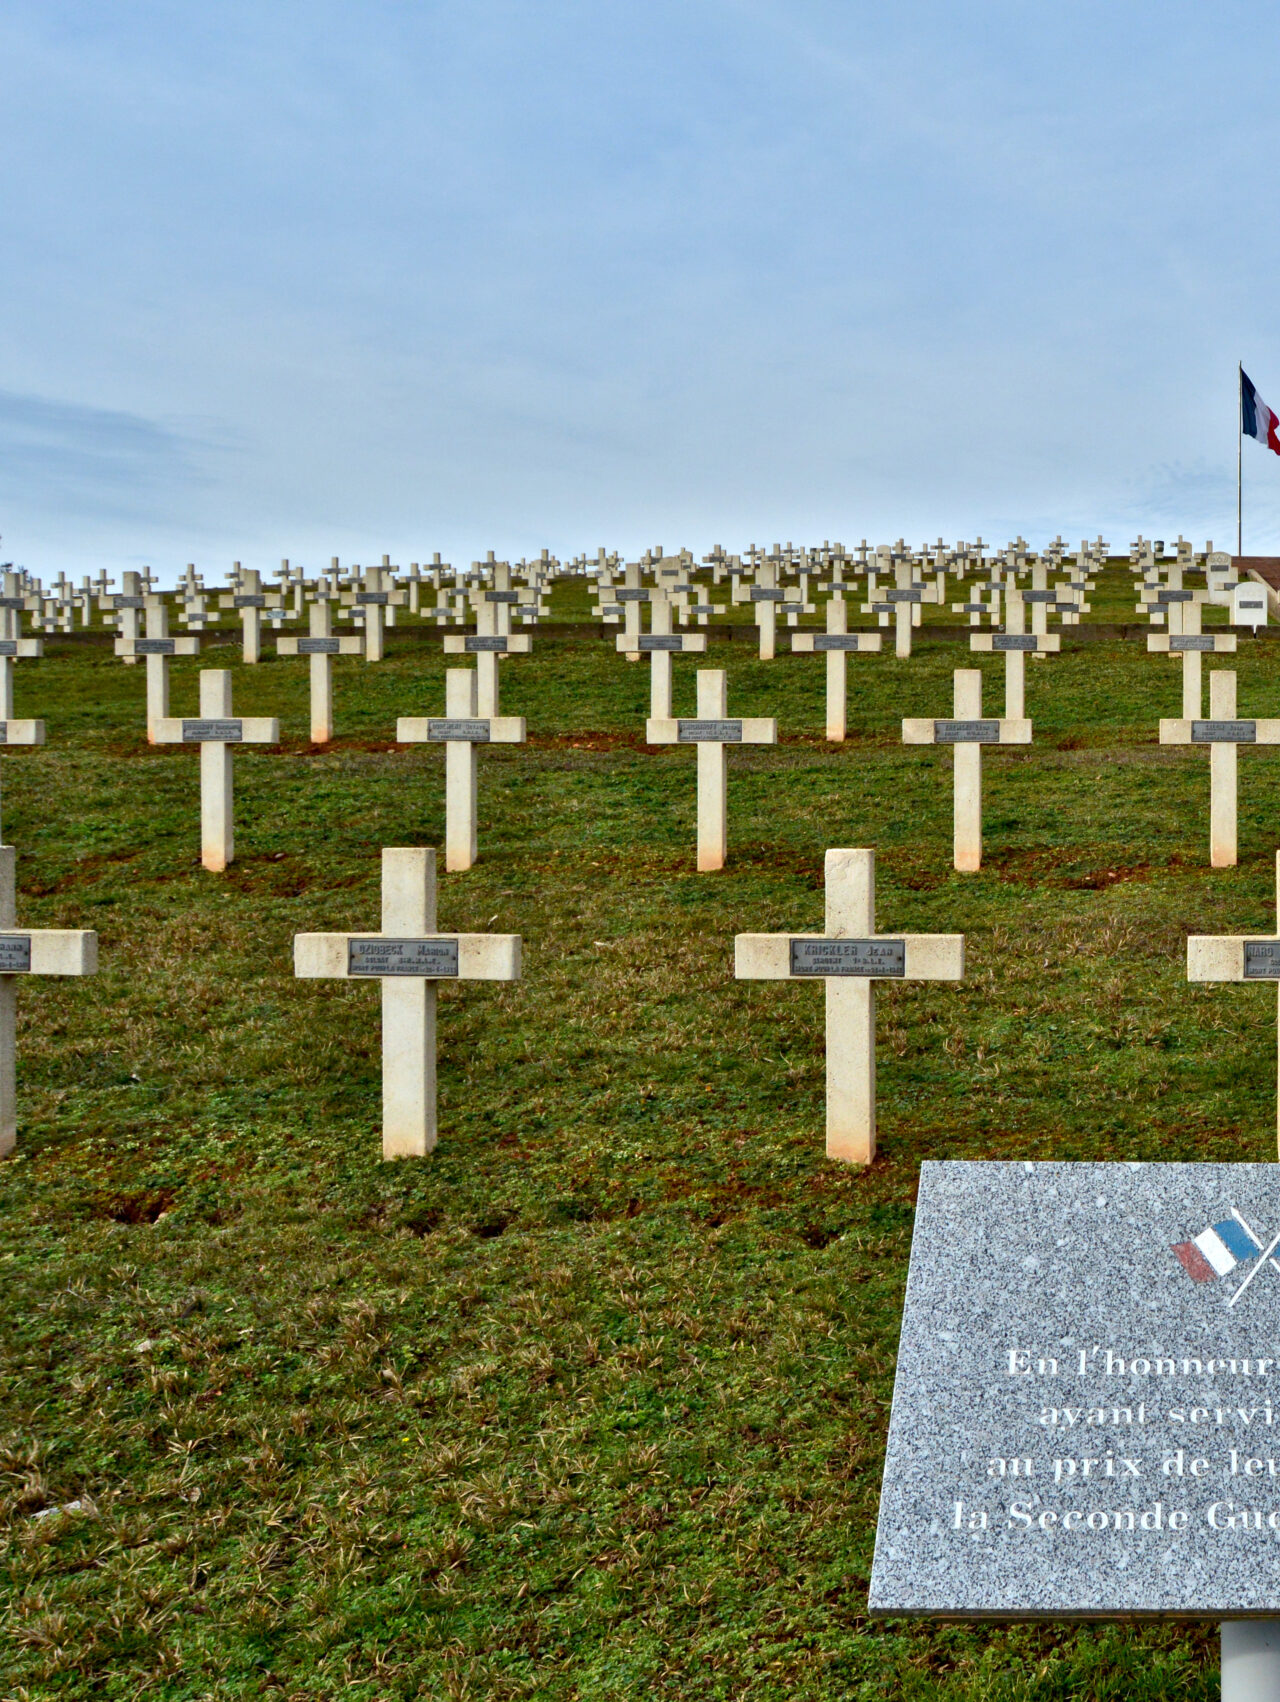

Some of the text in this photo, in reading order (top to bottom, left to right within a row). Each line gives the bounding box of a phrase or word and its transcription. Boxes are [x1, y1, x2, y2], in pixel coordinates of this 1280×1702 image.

[1006, 1349, 1058, 1376] En
[1077, 1346, 1273, 1376] l'honneur
[1039, 1402, 1146, 1430] ayant
[1169, 1399, 1273, 1425] servi
[987, 1456, 1033, 1477] au
[1054, 1450, 1143, 1484] prix
[1163, 1450, 1209, 1477] de
[951, 1501, 988, 1530] la
[1008, 1501, 1188, 1531] Seconde
